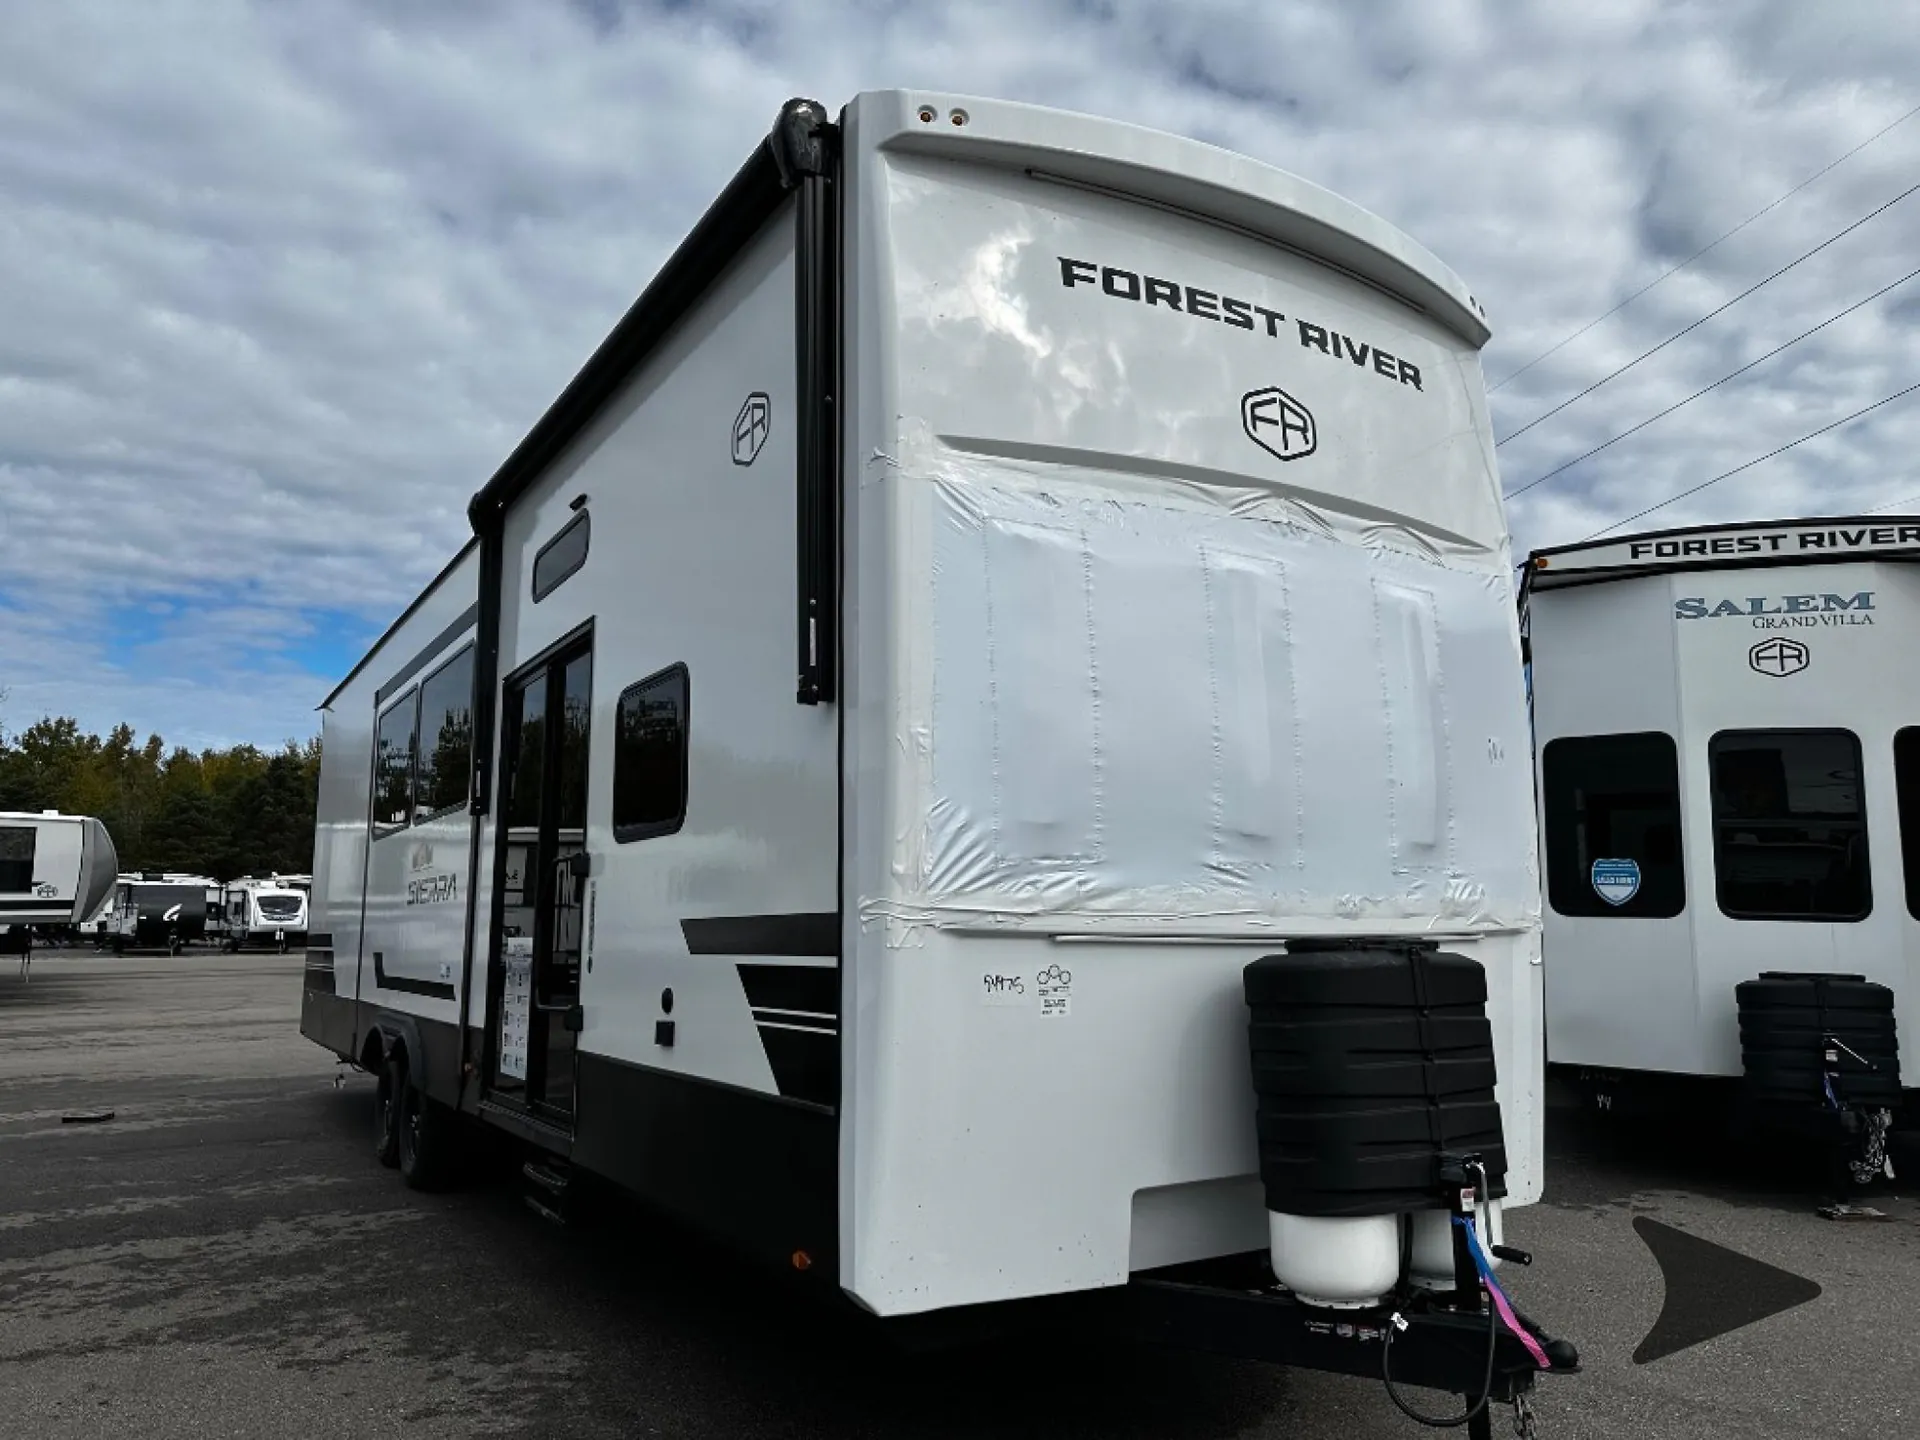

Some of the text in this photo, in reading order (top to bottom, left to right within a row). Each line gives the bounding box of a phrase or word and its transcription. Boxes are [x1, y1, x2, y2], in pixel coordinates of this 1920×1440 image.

[1056, 256, 1424, 393] FOREST RIVER
[736, 402, 766, 455] FR
[1250, 396, 1310, 451] FR
[1630, 526, 1920, 560] FOREST RIVER
[1675, 592, 1876, 619] SALEM
[1752, 612, 1875, 629] GRAND VILLA
[1755, 642, 1803, 672] FR
[407, 872, 457, 906] SIERRA
